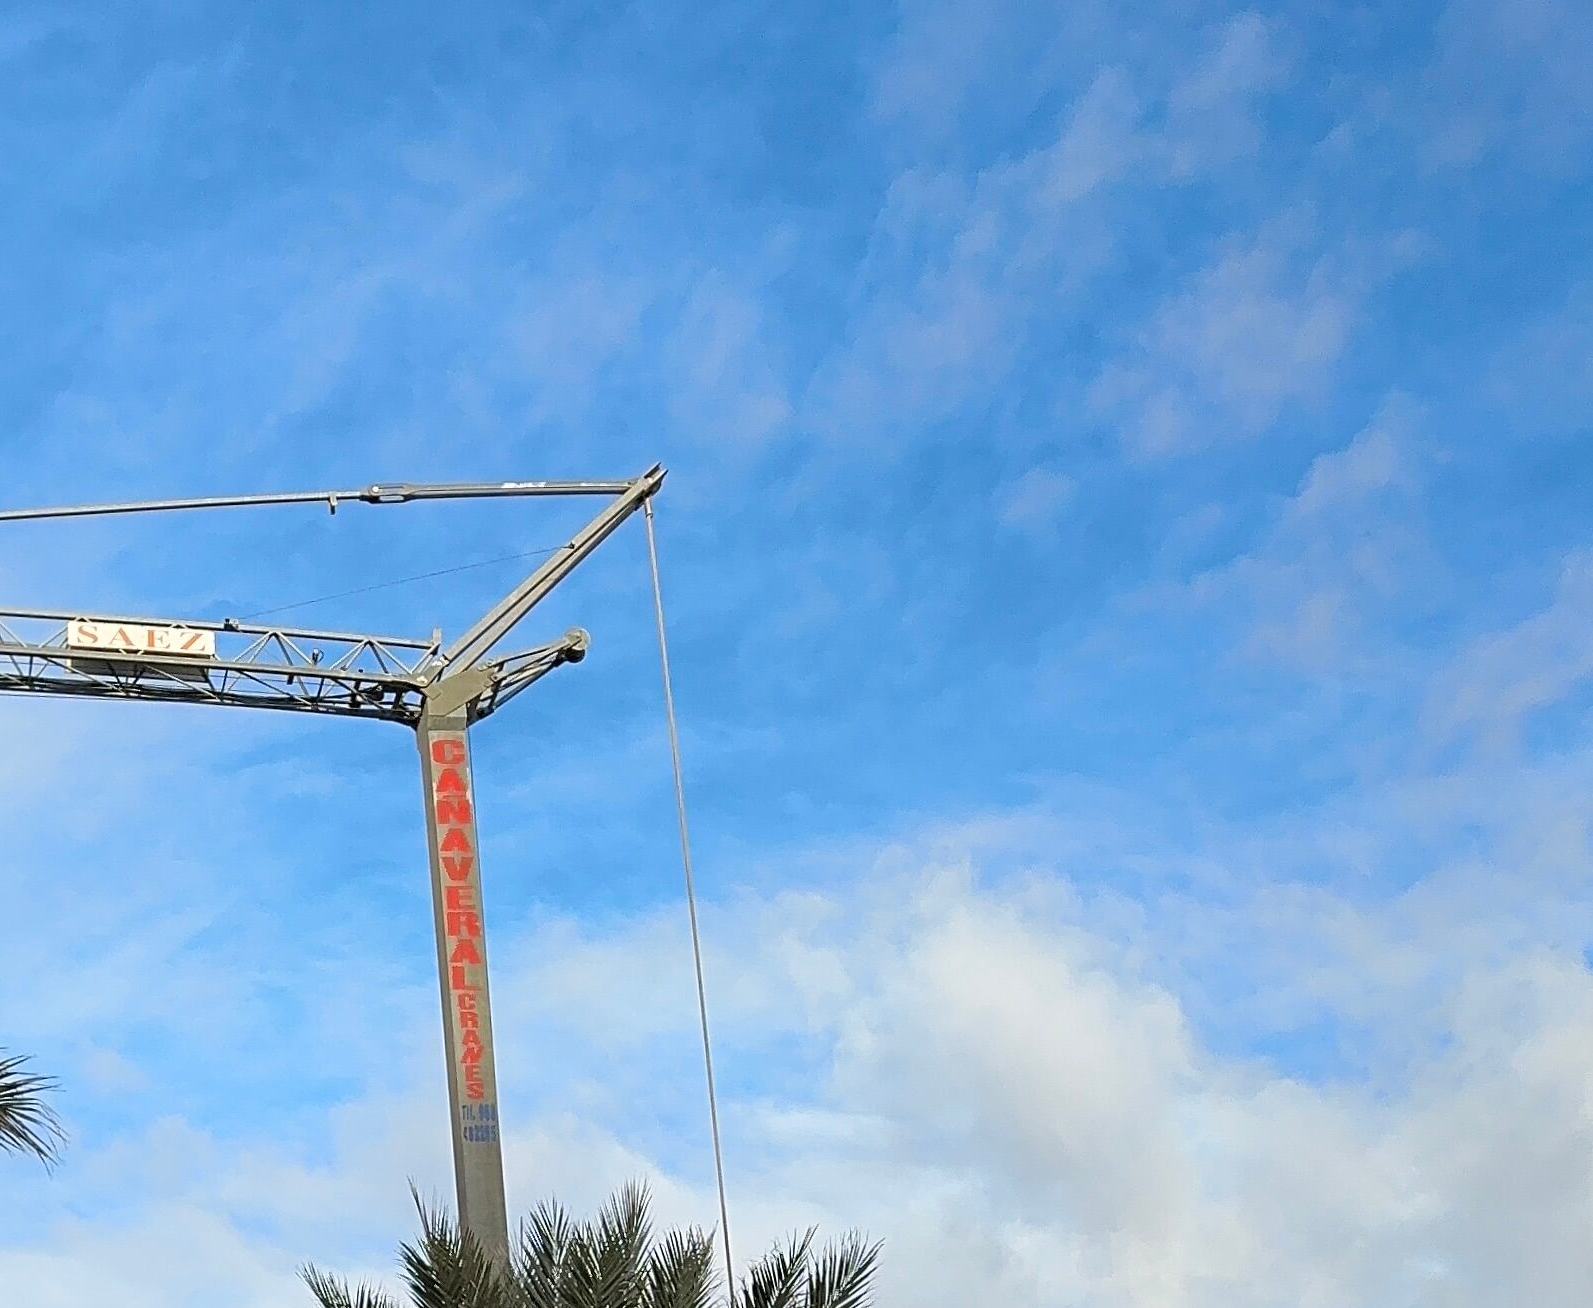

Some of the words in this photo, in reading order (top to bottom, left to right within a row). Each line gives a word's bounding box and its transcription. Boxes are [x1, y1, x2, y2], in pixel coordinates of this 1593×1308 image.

[76, 623, 206, 652] SAEZ
[431, 739, 482, 991] CANAVERAL
[457, 993, 484, 1099] CRANES
